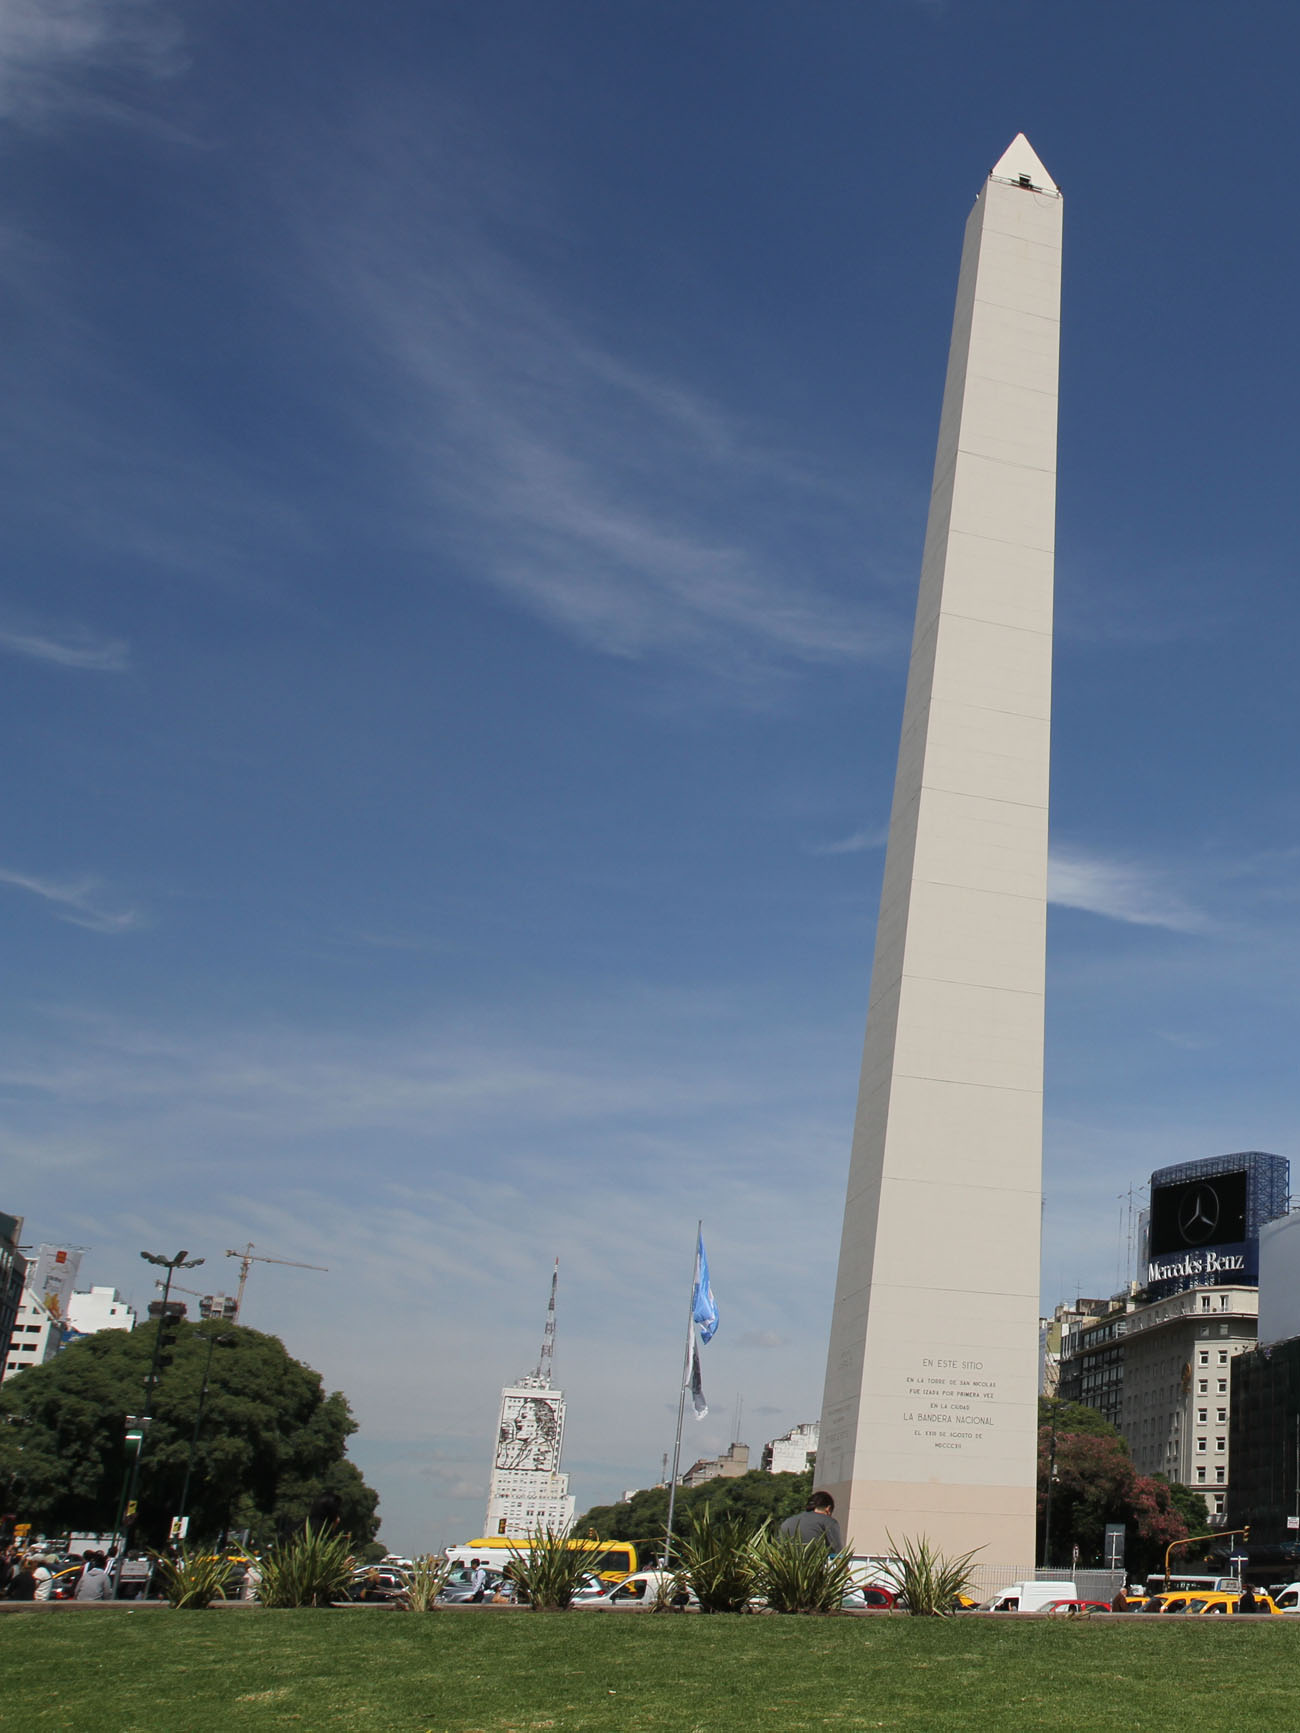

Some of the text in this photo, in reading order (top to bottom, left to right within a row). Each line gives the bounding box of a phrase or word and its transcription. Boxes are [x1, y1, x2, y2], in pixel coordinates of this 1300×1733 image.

[922, 1358, 984, 1370] EN ESTE SITIO
[903, 1412, 994, 1425] LA BANDERA NACIONAL
